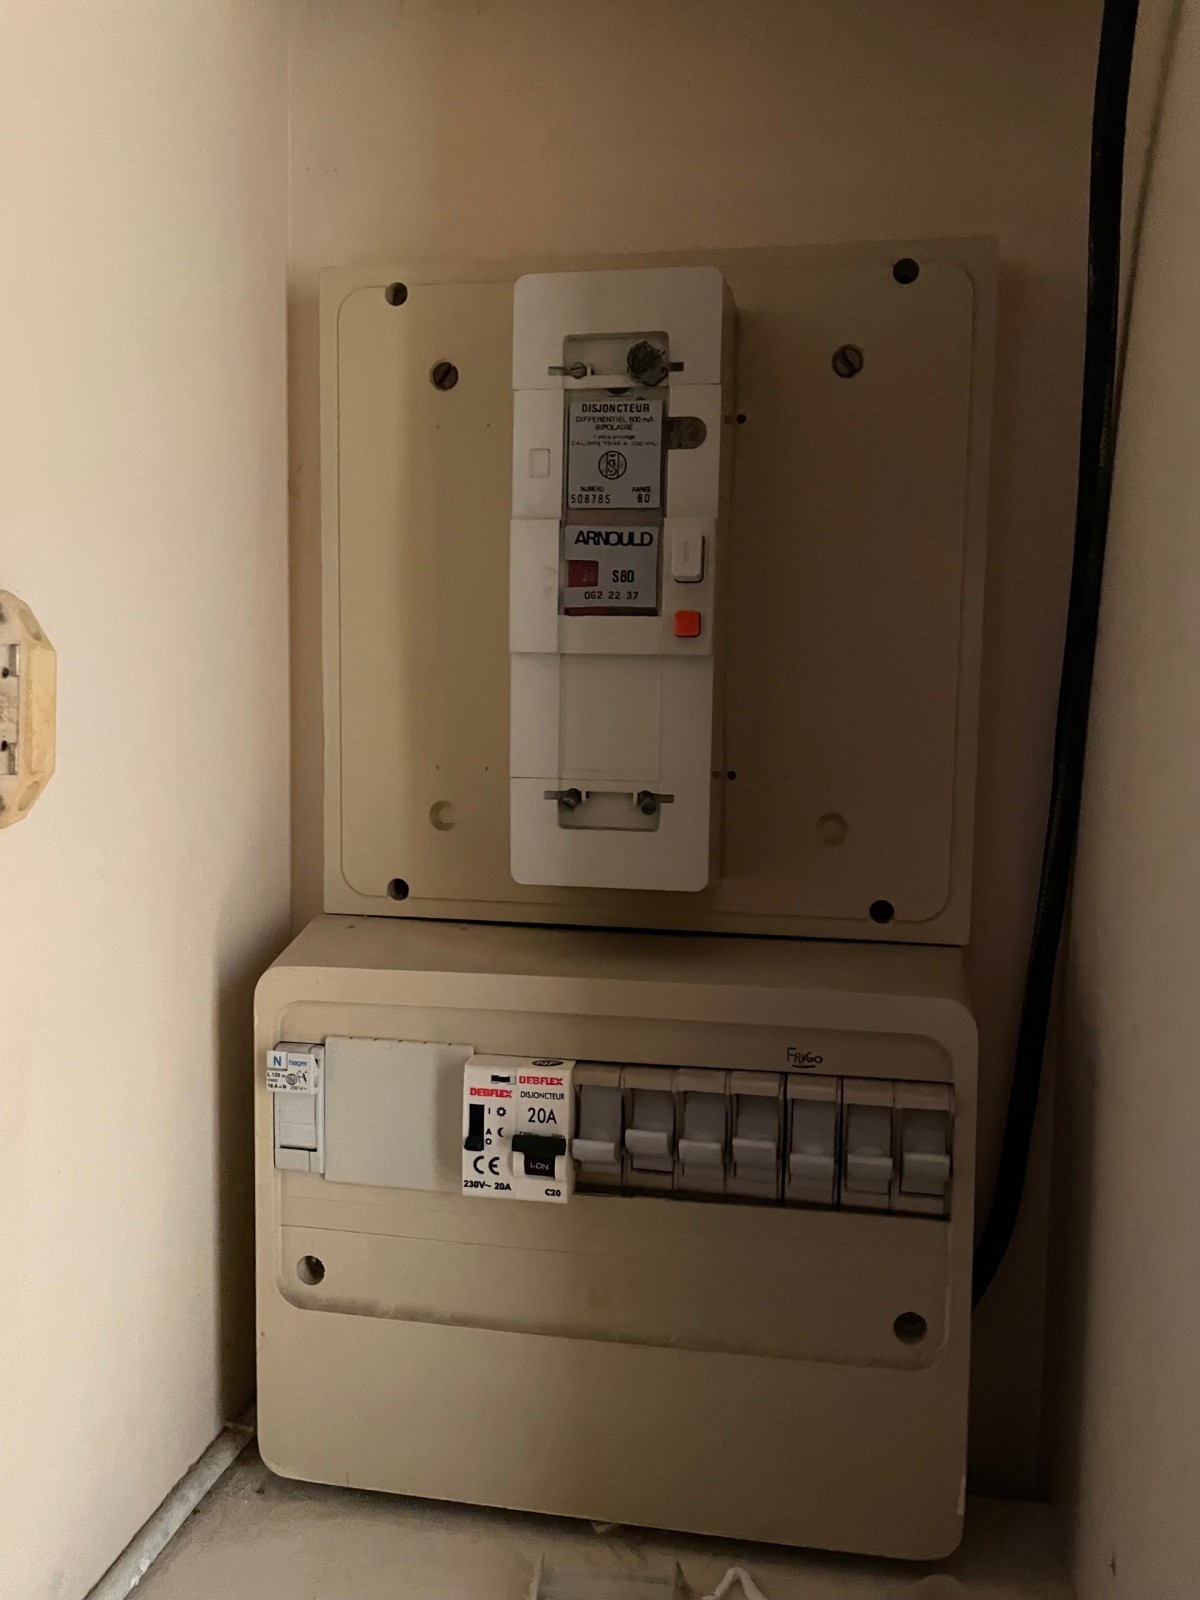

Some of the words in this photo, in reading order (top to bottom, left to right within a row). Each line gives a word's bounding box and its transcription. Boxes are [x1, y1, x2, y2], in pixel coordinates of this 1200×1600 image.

[581, 403, 650, 413] DISJONCTEUR
[574, 530, 654, 547] ARNOULD
[584, 591, 603, 600] 062
[608, 591, 621, 600] 22
[626, 591, 639, 600] 37
[273, 1056, 282, 1066] N
[518, 1075, 564, 1086] DEBFLEX
[469, 1087, 512, 1098] DEBFLEX
[520, 1091, 565, 1100] DISJONCTEUR
[527, 1107, 557, 1124] 20A
[473, 1155, 500, 1175] CE
[494, 1182, 512, 1191] 20A
[544, 1189, 562, 1197] C20
